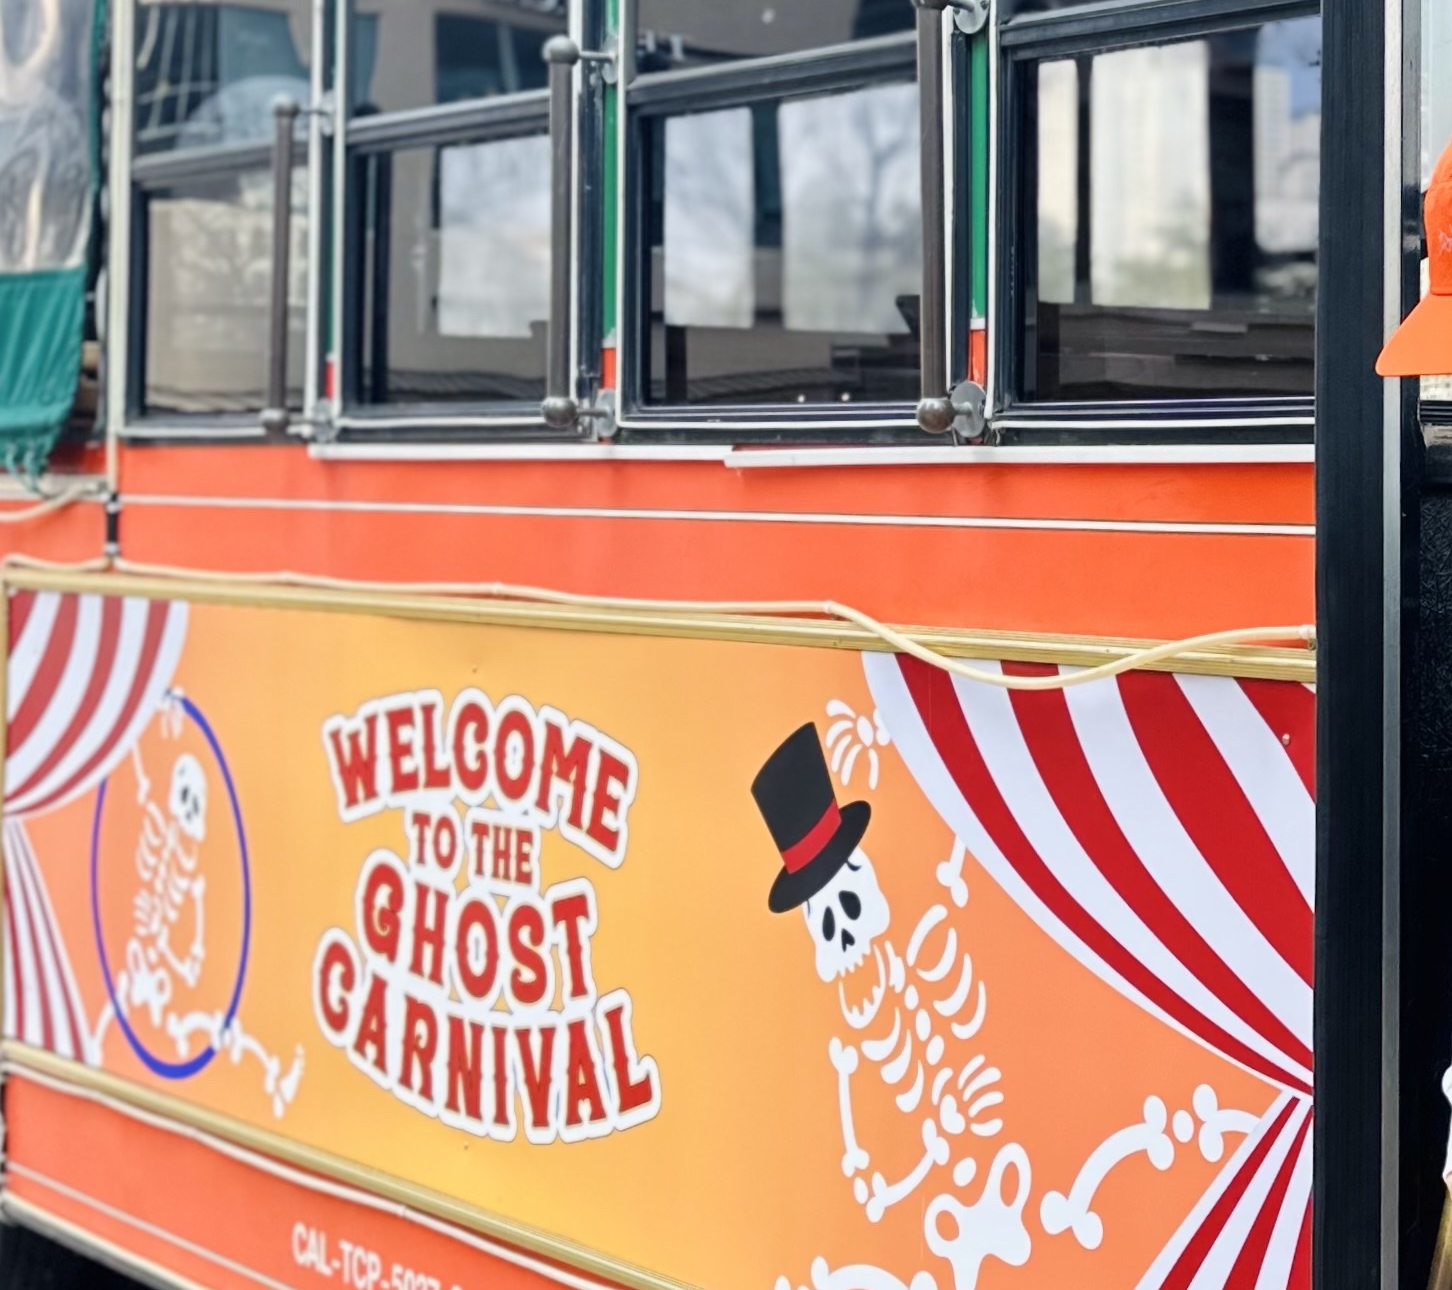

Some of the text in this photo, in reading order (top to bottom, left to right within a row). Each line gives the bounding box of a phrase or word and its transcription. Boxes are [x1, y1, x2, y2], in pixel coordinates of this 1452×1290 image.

[329, 702, 631, 853] WELCOME
[411, 812, 533, 885] TO THE
[361, 861, 591, 1006] GHOST
[318, 940, 653, 1129] CARNIVAL
